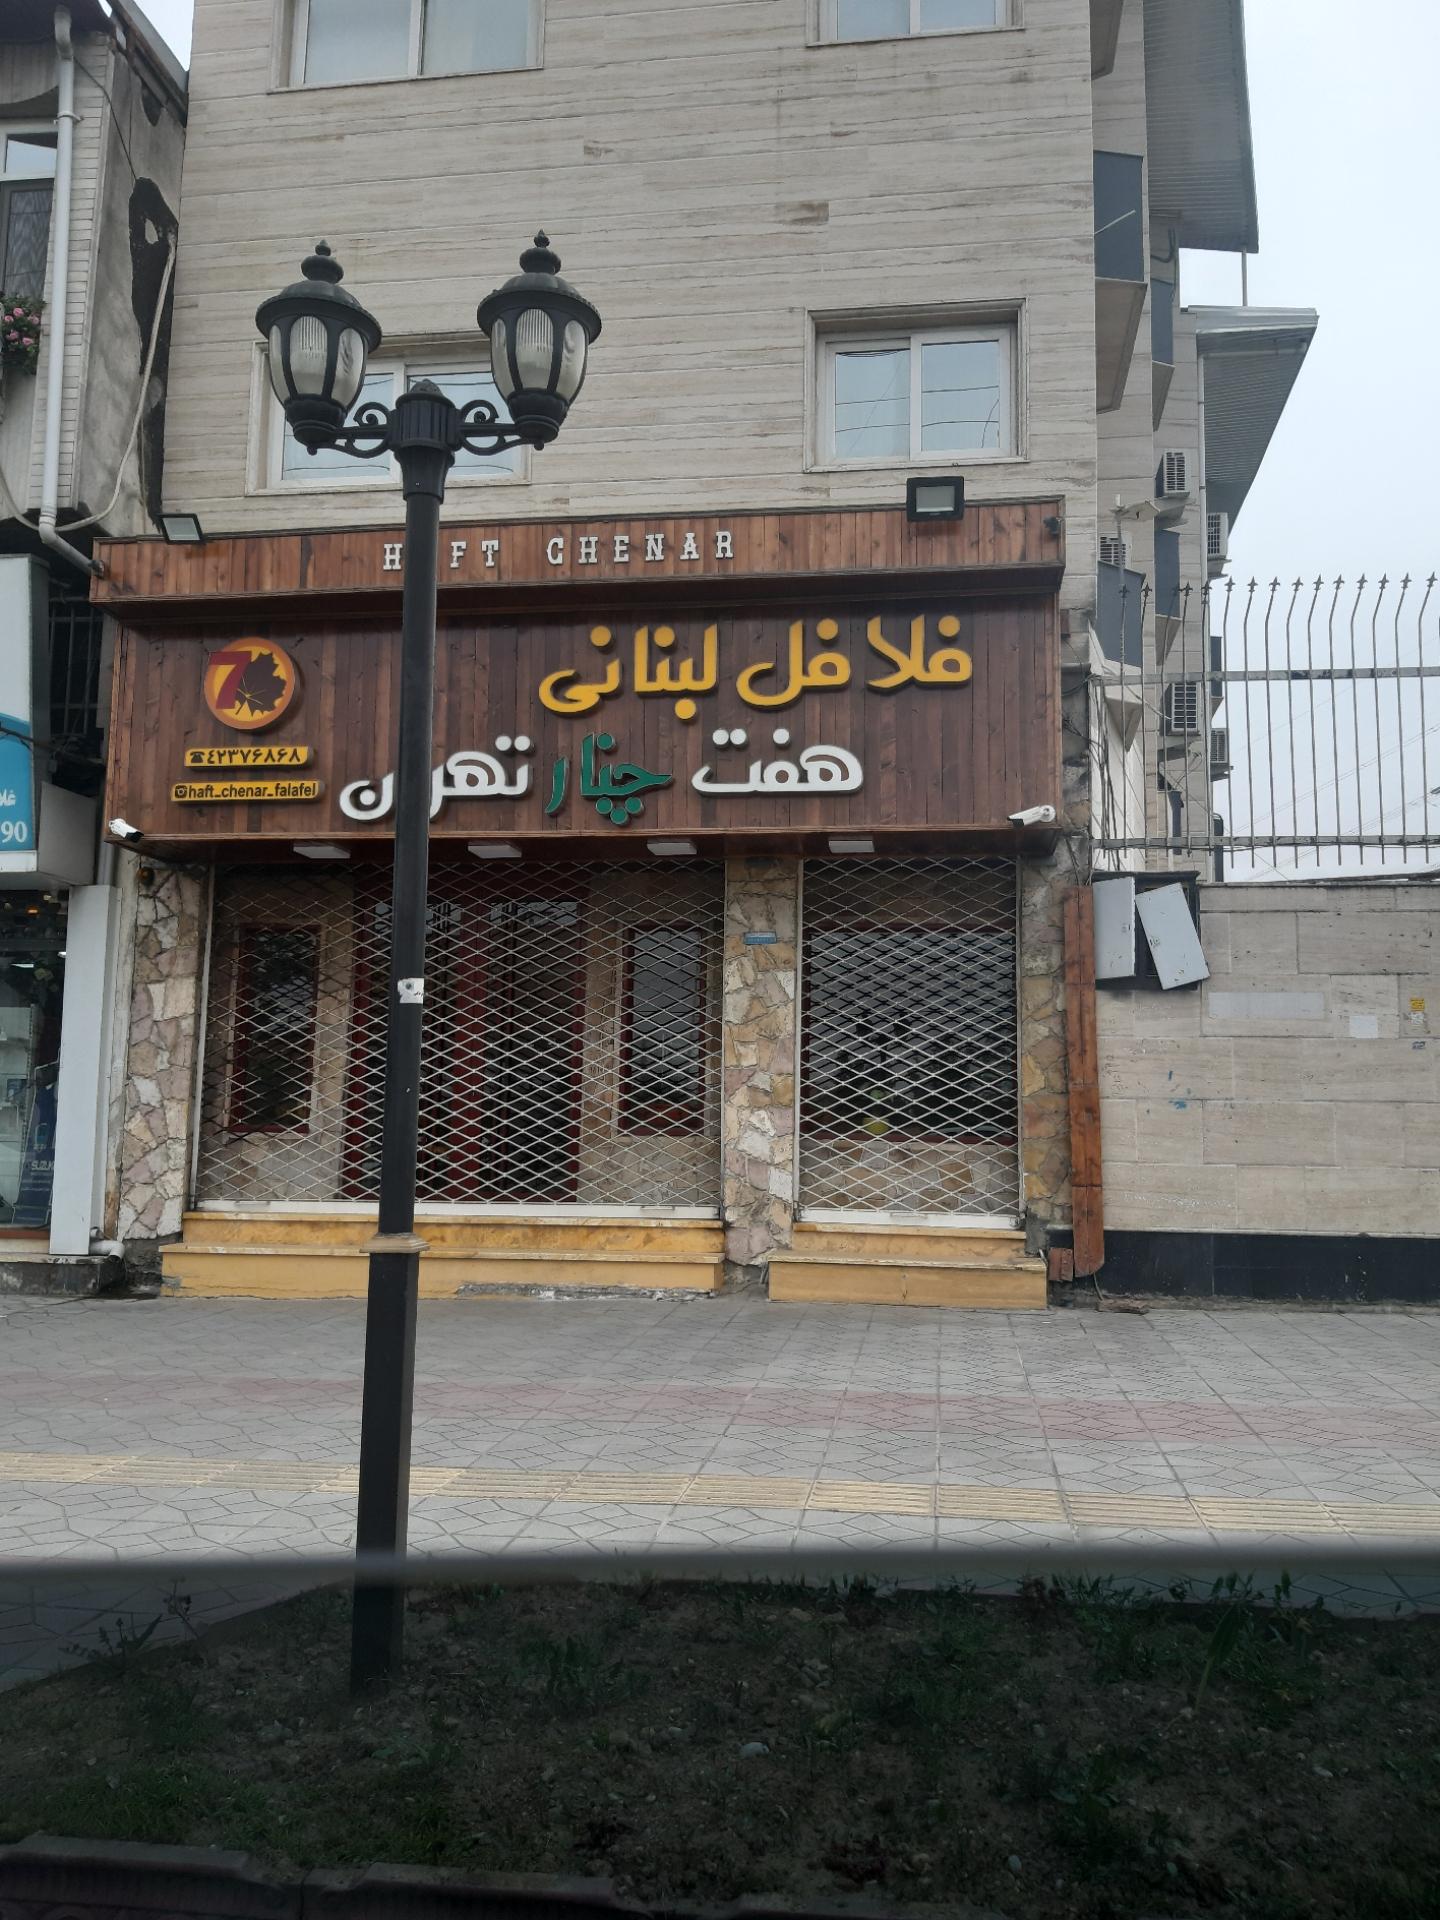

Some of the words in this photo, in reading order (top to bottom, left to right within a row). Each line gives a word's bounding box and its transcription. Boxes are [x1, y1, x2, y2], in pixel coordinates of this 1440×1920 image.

[382, 539, 500, 571] HFT
[546, 530, 735, 566] CHENAR
[208, 651, 252, 710] 7
[735, 614, 973, 707] فلافل
[188, 783, 316, 798] haft_chenar_falafel
[339, 735, 532, 821] تهرن
[544, 732, 674, 826] چنار
[690, 727, 865, 795] هفت
